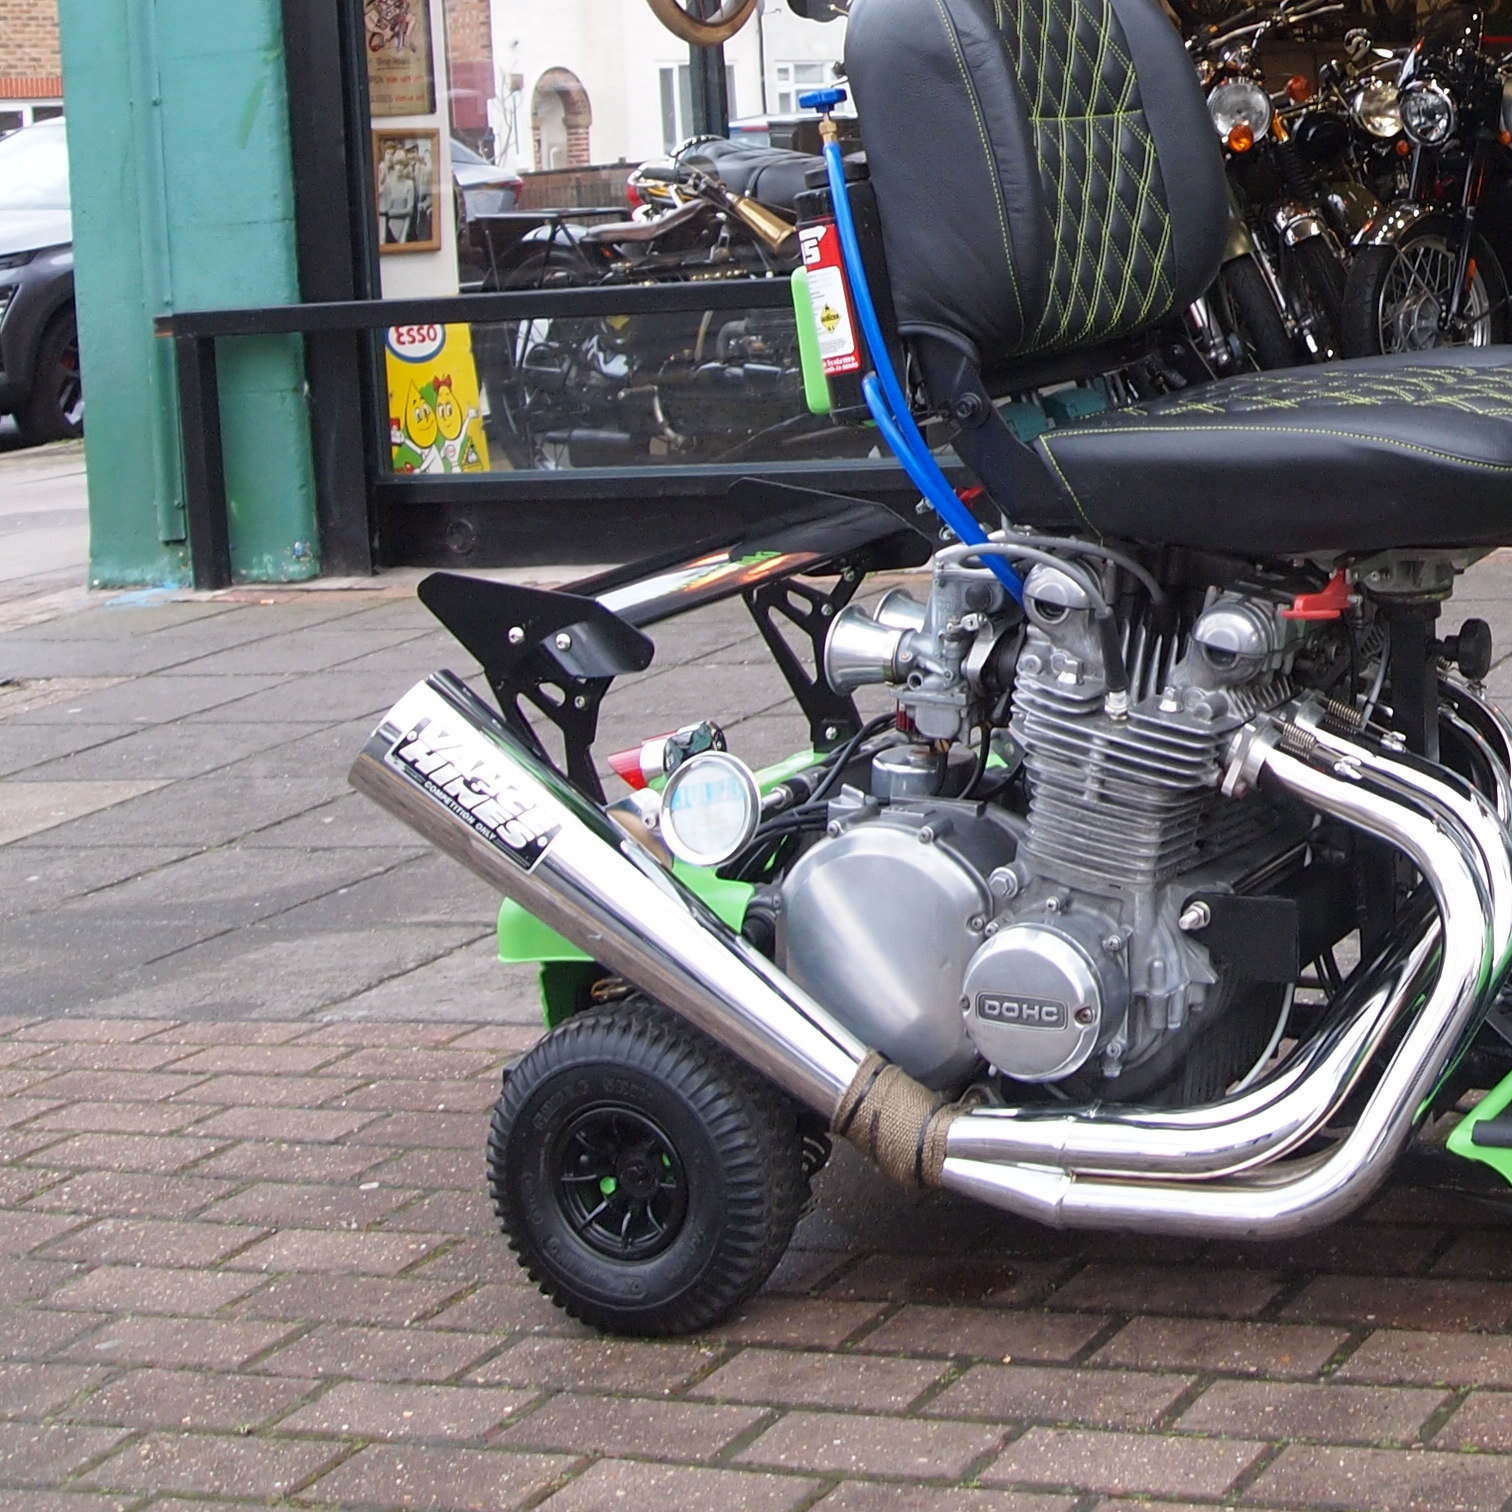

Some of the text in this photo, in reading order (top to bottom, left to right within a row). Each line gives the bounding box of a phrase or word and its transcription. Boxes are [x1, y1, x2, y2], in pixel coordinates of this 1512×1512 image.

[399, 738, 536, 848] HINES
[424, 780, 497, 840] COMPETITION ONLY
[984, 999, 1059, 1023] DOHC
